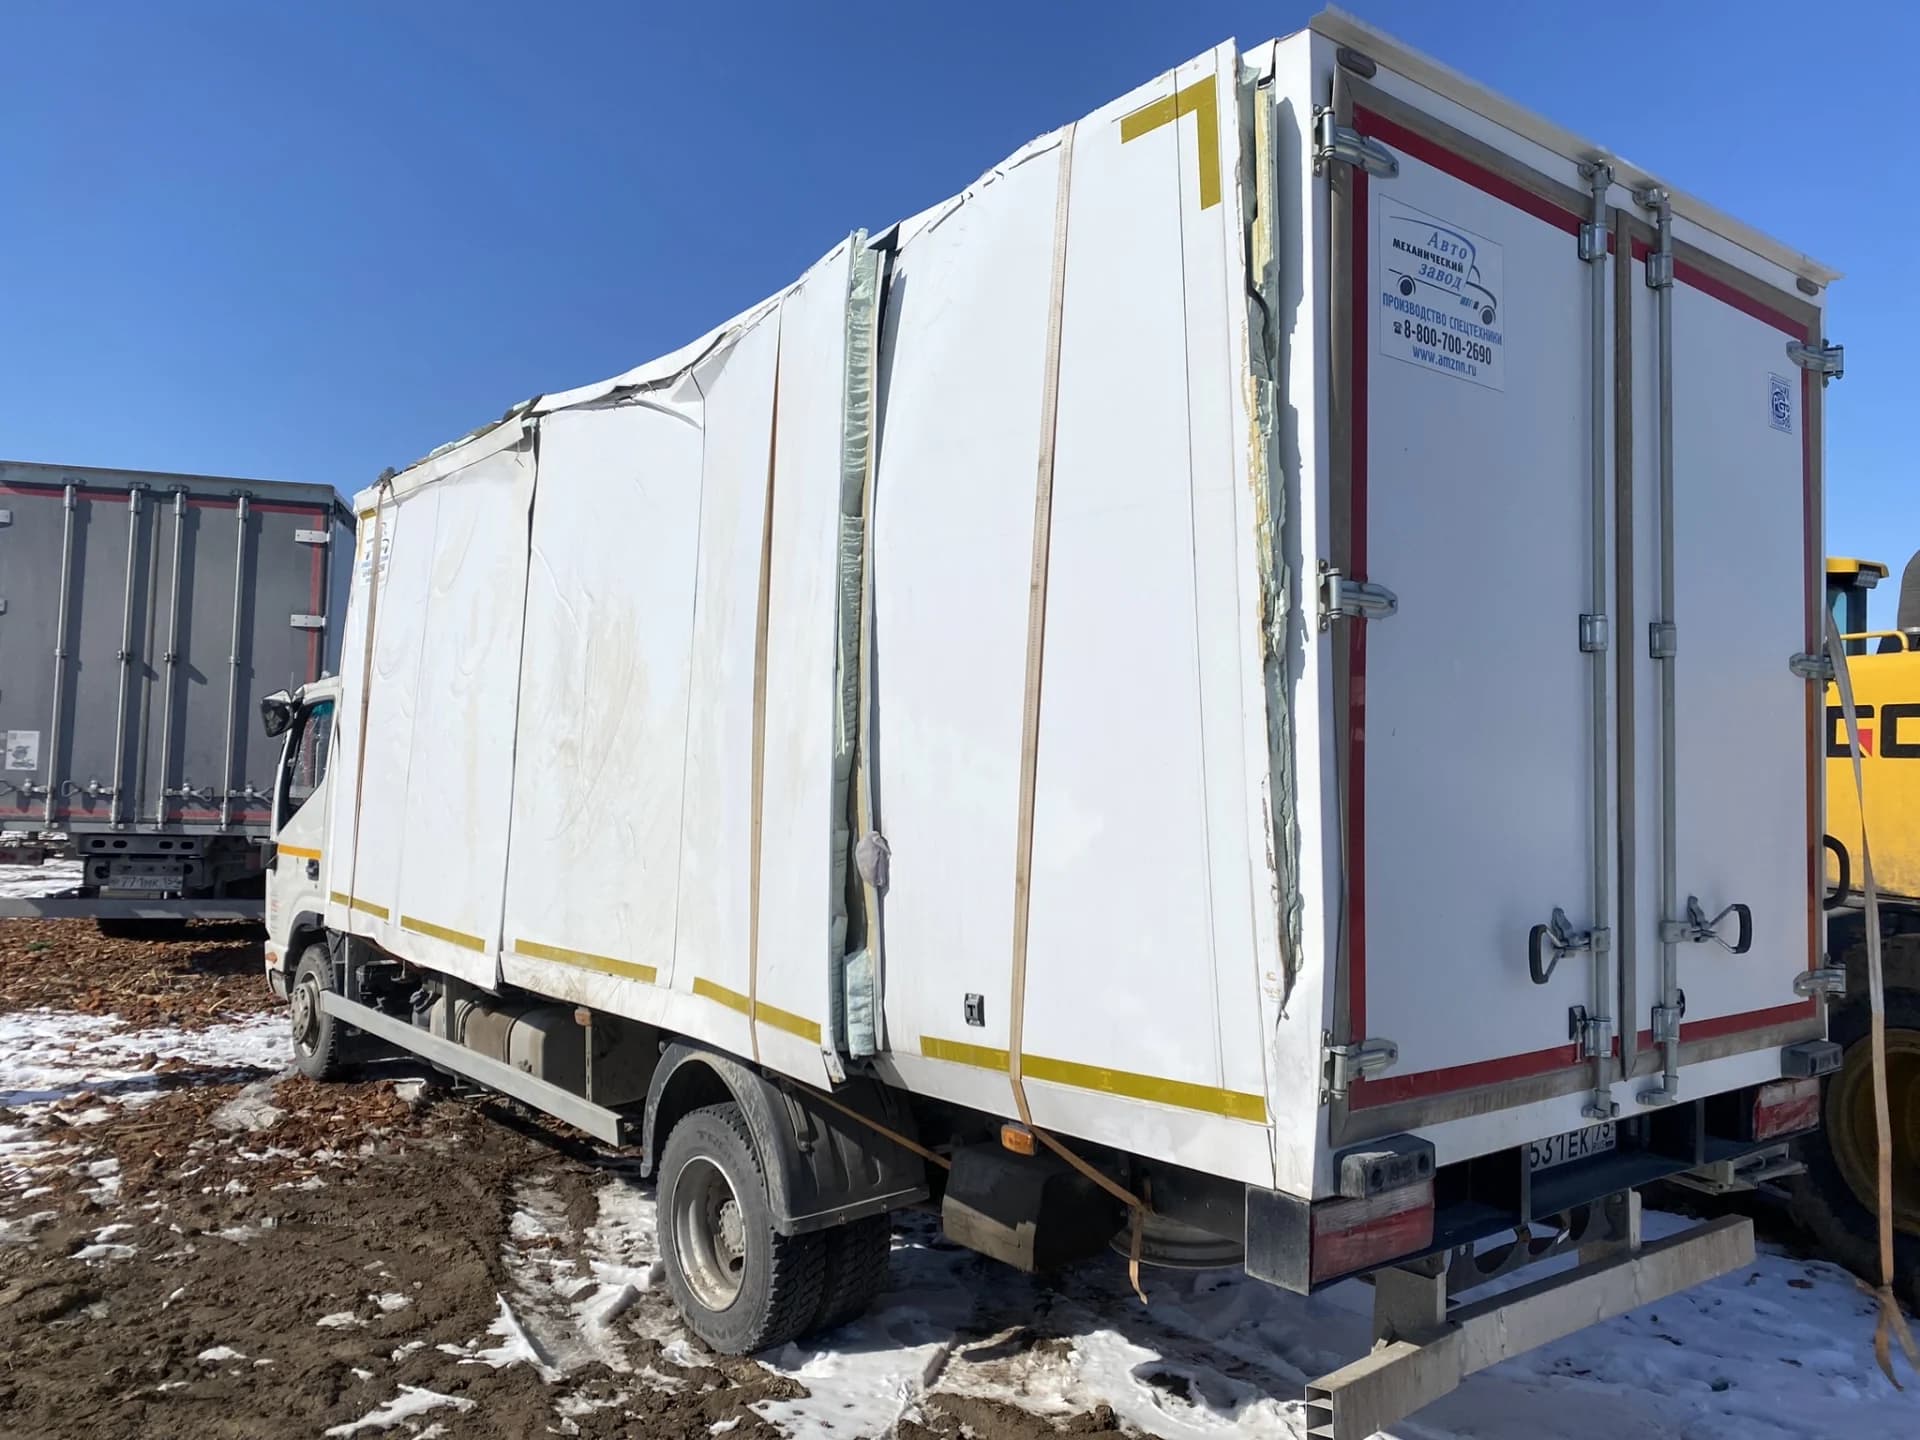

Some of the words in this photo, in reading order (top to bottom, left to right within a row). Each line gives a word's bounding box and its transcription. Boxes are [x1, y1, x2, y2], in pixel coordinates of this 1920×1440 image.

[1393, 238, 1464, 274] МЕХАНИЧЕСКИЙ
[1382, 292, 1447, 326] ПРОИЗВОДСТВО
[1450, 316, 1503, 347] СПЕЦТЕХНИКИ
[1404, 319, 1492, 366] 8-800-700-2690
[1412, 346, 1477, 377] www.amznn.ru
